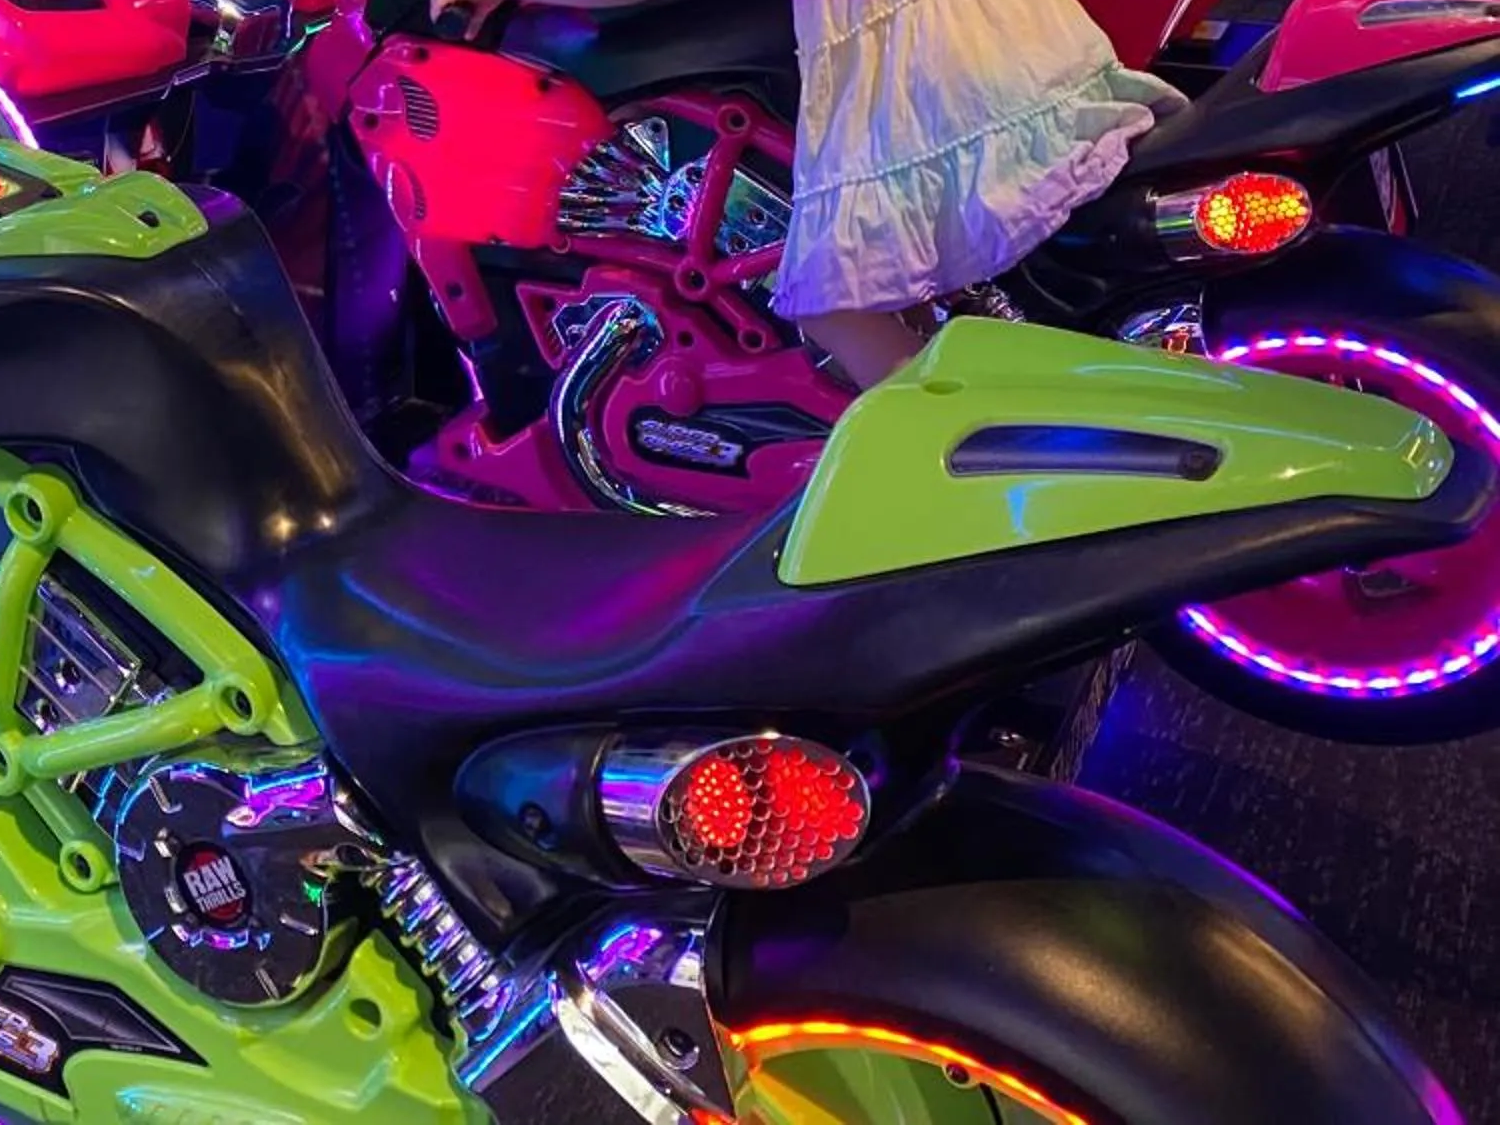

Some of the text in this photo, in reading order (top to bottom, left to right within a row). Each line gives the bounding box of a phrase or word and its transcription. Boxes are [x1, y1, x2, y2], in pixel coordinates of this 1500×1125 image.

[183, 856, 237, 899] RAW
[196, 880, 246, 913] THRILLS
[17, 1029, 58, 1073] 3
